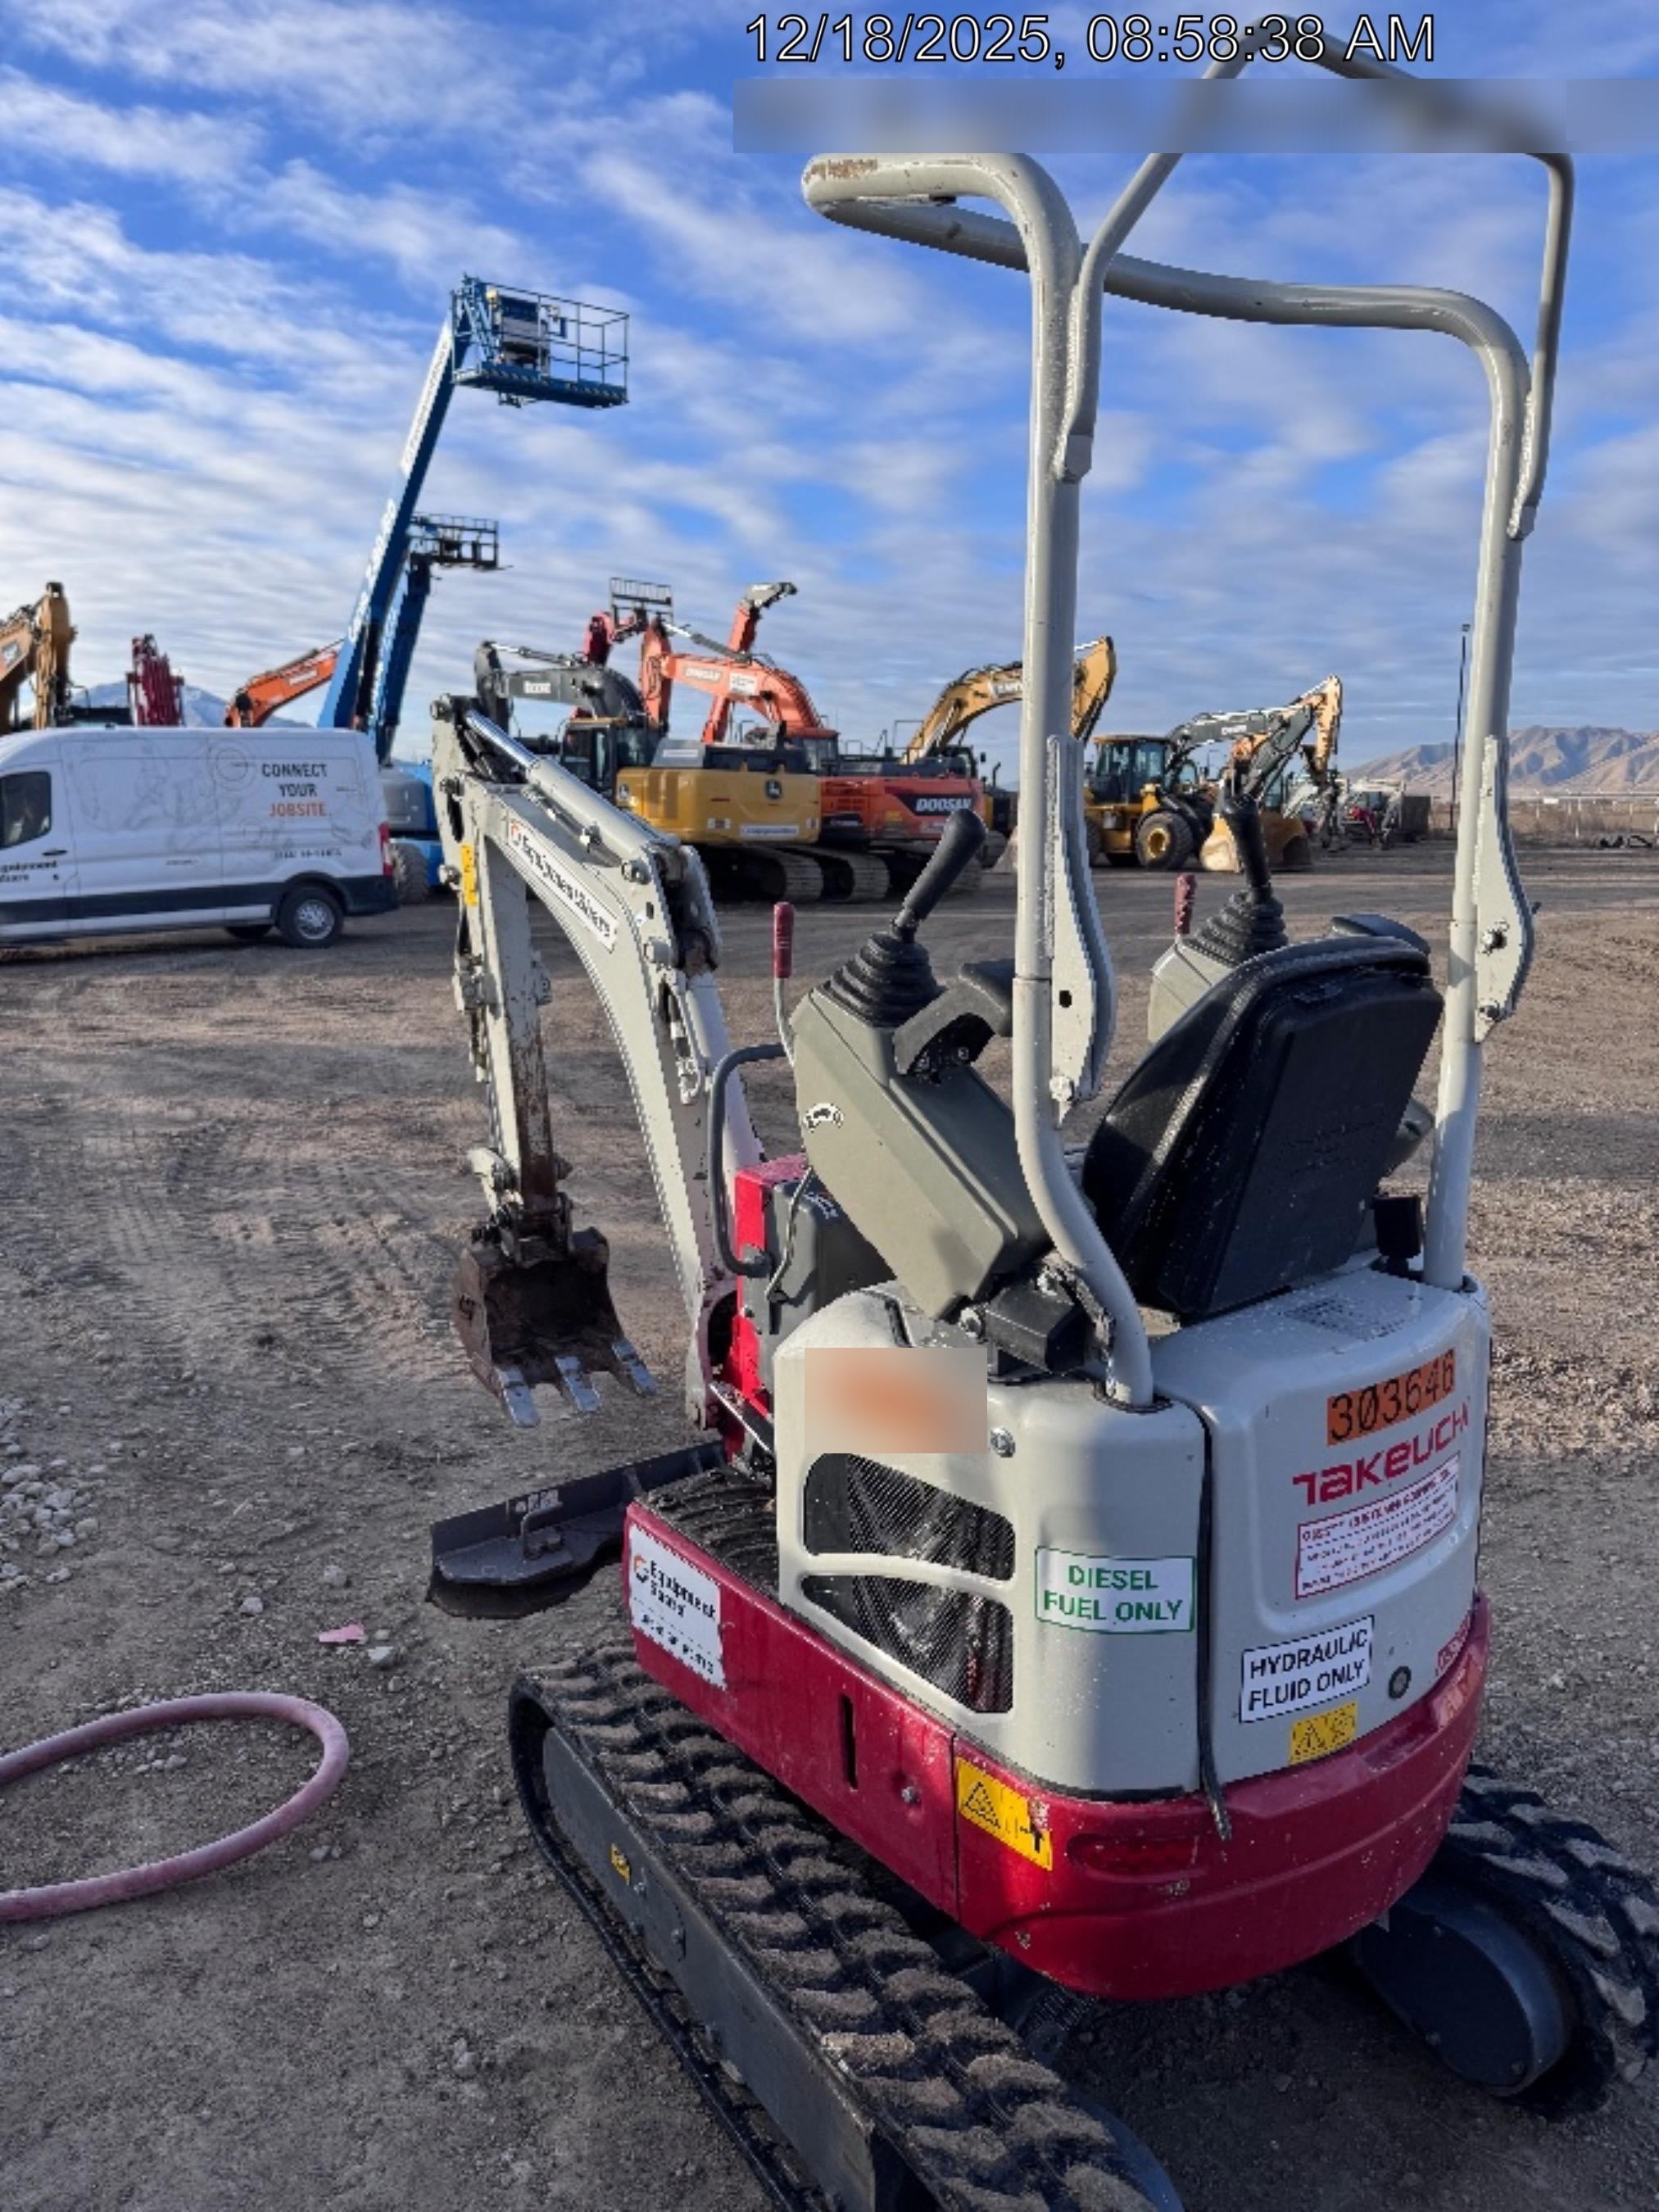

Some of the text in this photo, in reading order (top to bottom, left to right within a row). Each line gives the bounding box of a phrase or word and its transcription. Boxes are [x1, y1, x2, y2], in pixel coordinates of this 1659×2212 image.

[262, 763, 328, 777] CONNECT
[279, 783, 318, 797] YOUR
[916, 797, 972, 812] DOOSAN
[1067, 1564, 1159, 1591] DIESEL
[1044, 1589, 1183, 1622] FUEL ONLY
[1250, 1628, 1368, 1679] HYDRAULIC
[1248, 1659, 1367, 1711] FLUID ONLY
